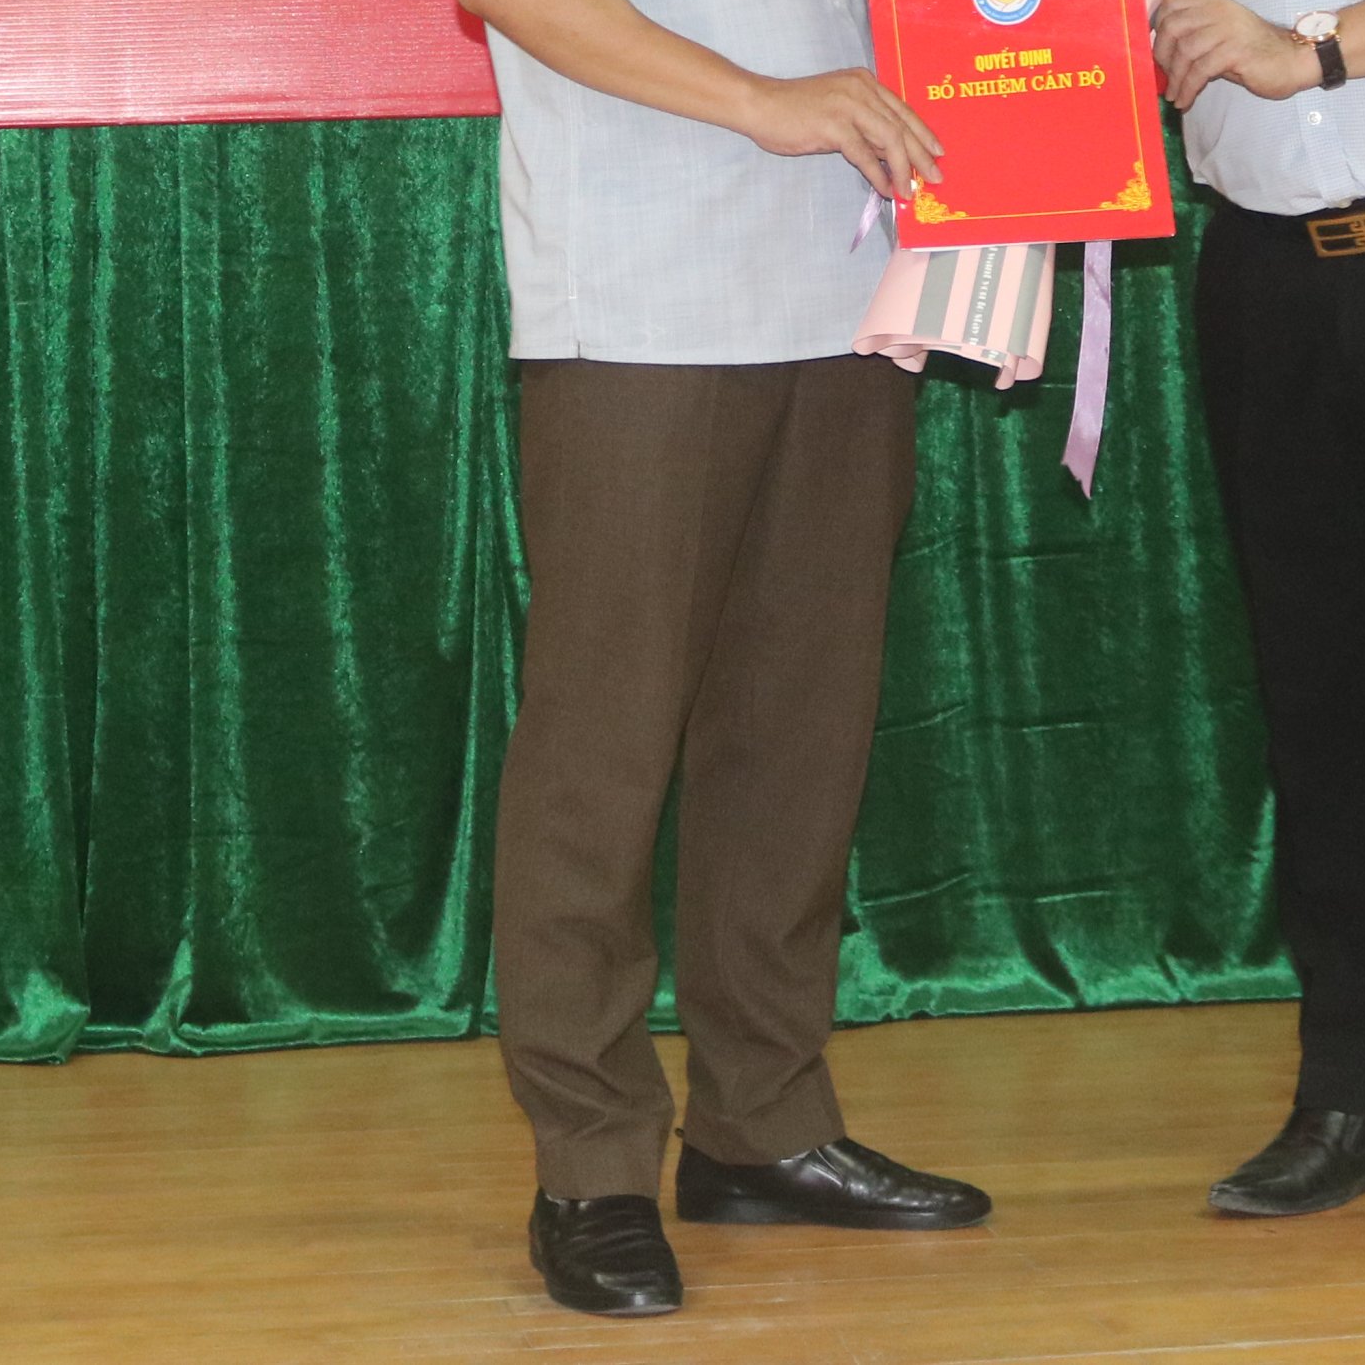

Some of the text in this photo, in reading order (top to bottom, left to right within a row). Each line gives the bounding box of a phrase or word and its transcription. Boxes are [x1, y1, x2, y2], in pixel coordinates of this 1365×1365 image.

[975, 47, 1053, 72] QUYẾT ĐỊNH
[927, 65, 1106, 100] BỔ NHIỆM CÁN BỘ
